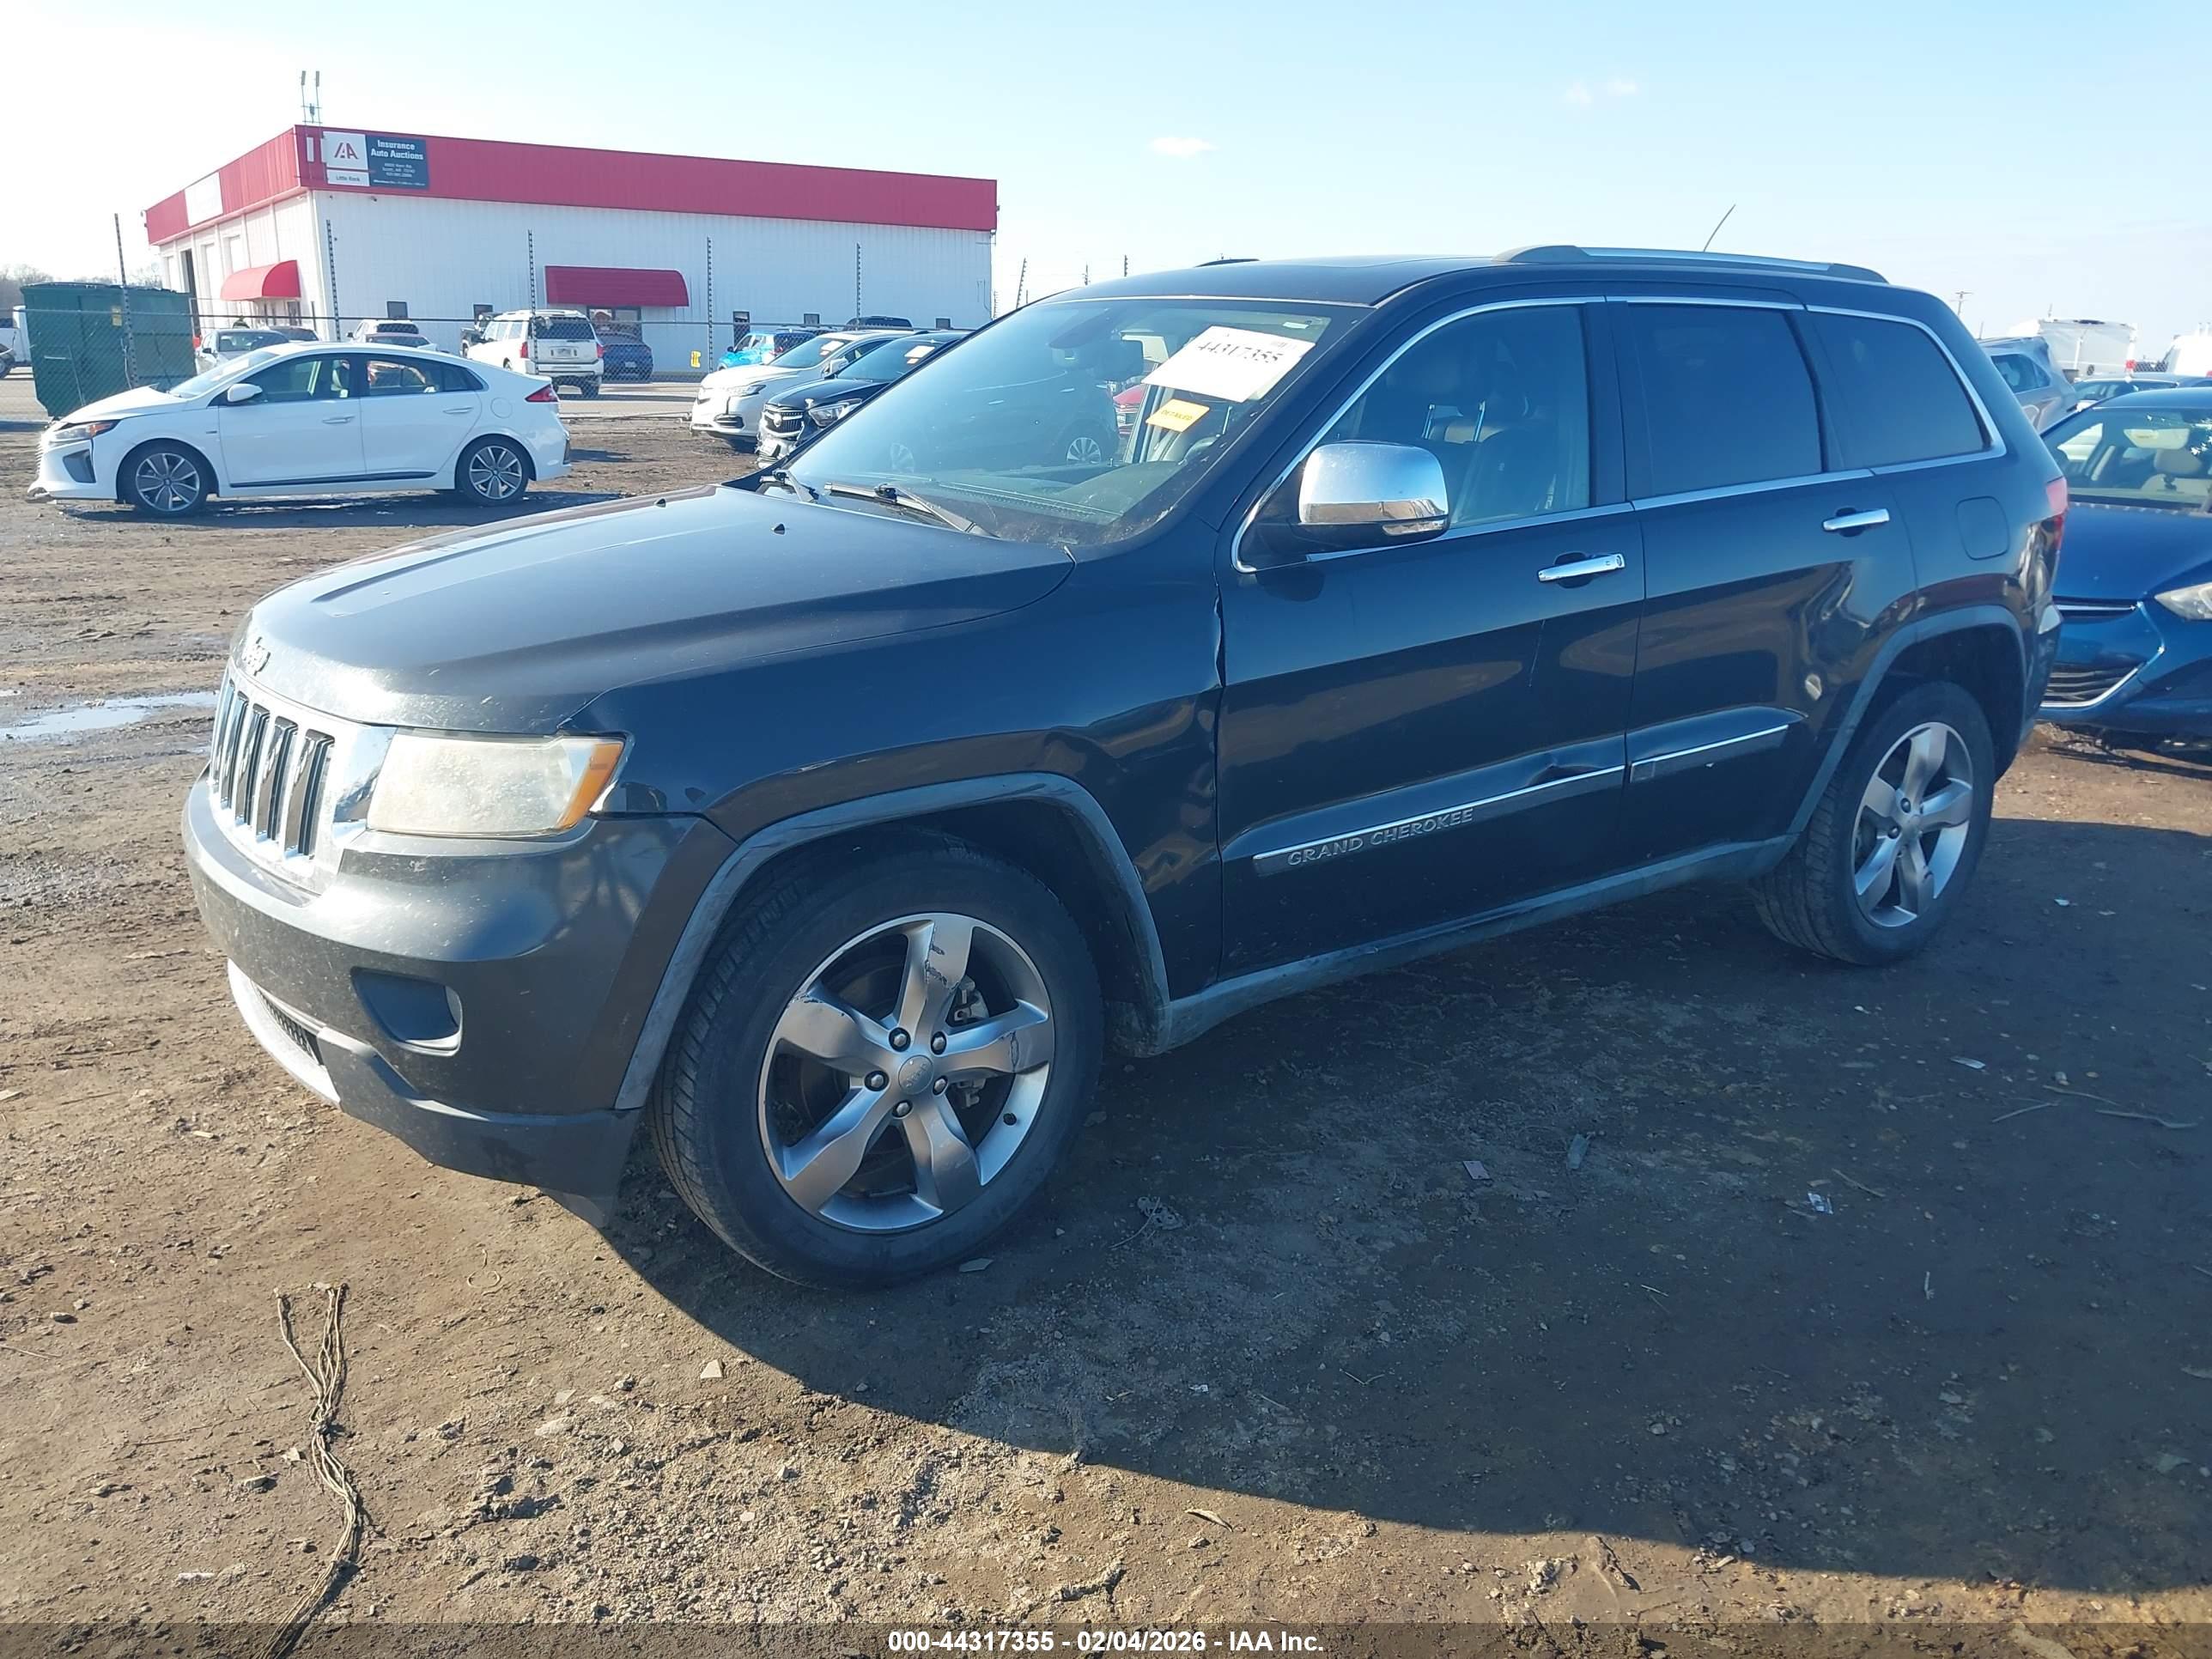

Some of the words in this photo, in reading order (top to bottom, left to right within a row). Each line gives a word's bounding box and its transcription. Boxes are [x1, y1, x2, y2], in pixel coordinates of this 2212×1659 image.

[377, 139, 416, 150] Insurance
[371, 148, 389, 158] Auto
[390, 149, 424, 161] Auctions
[1198, 342, 1284, 364] 44317355
[1288, 837, 1364, 866] GRAND
[1370, 808, 1474, 845] CHEROKEE
